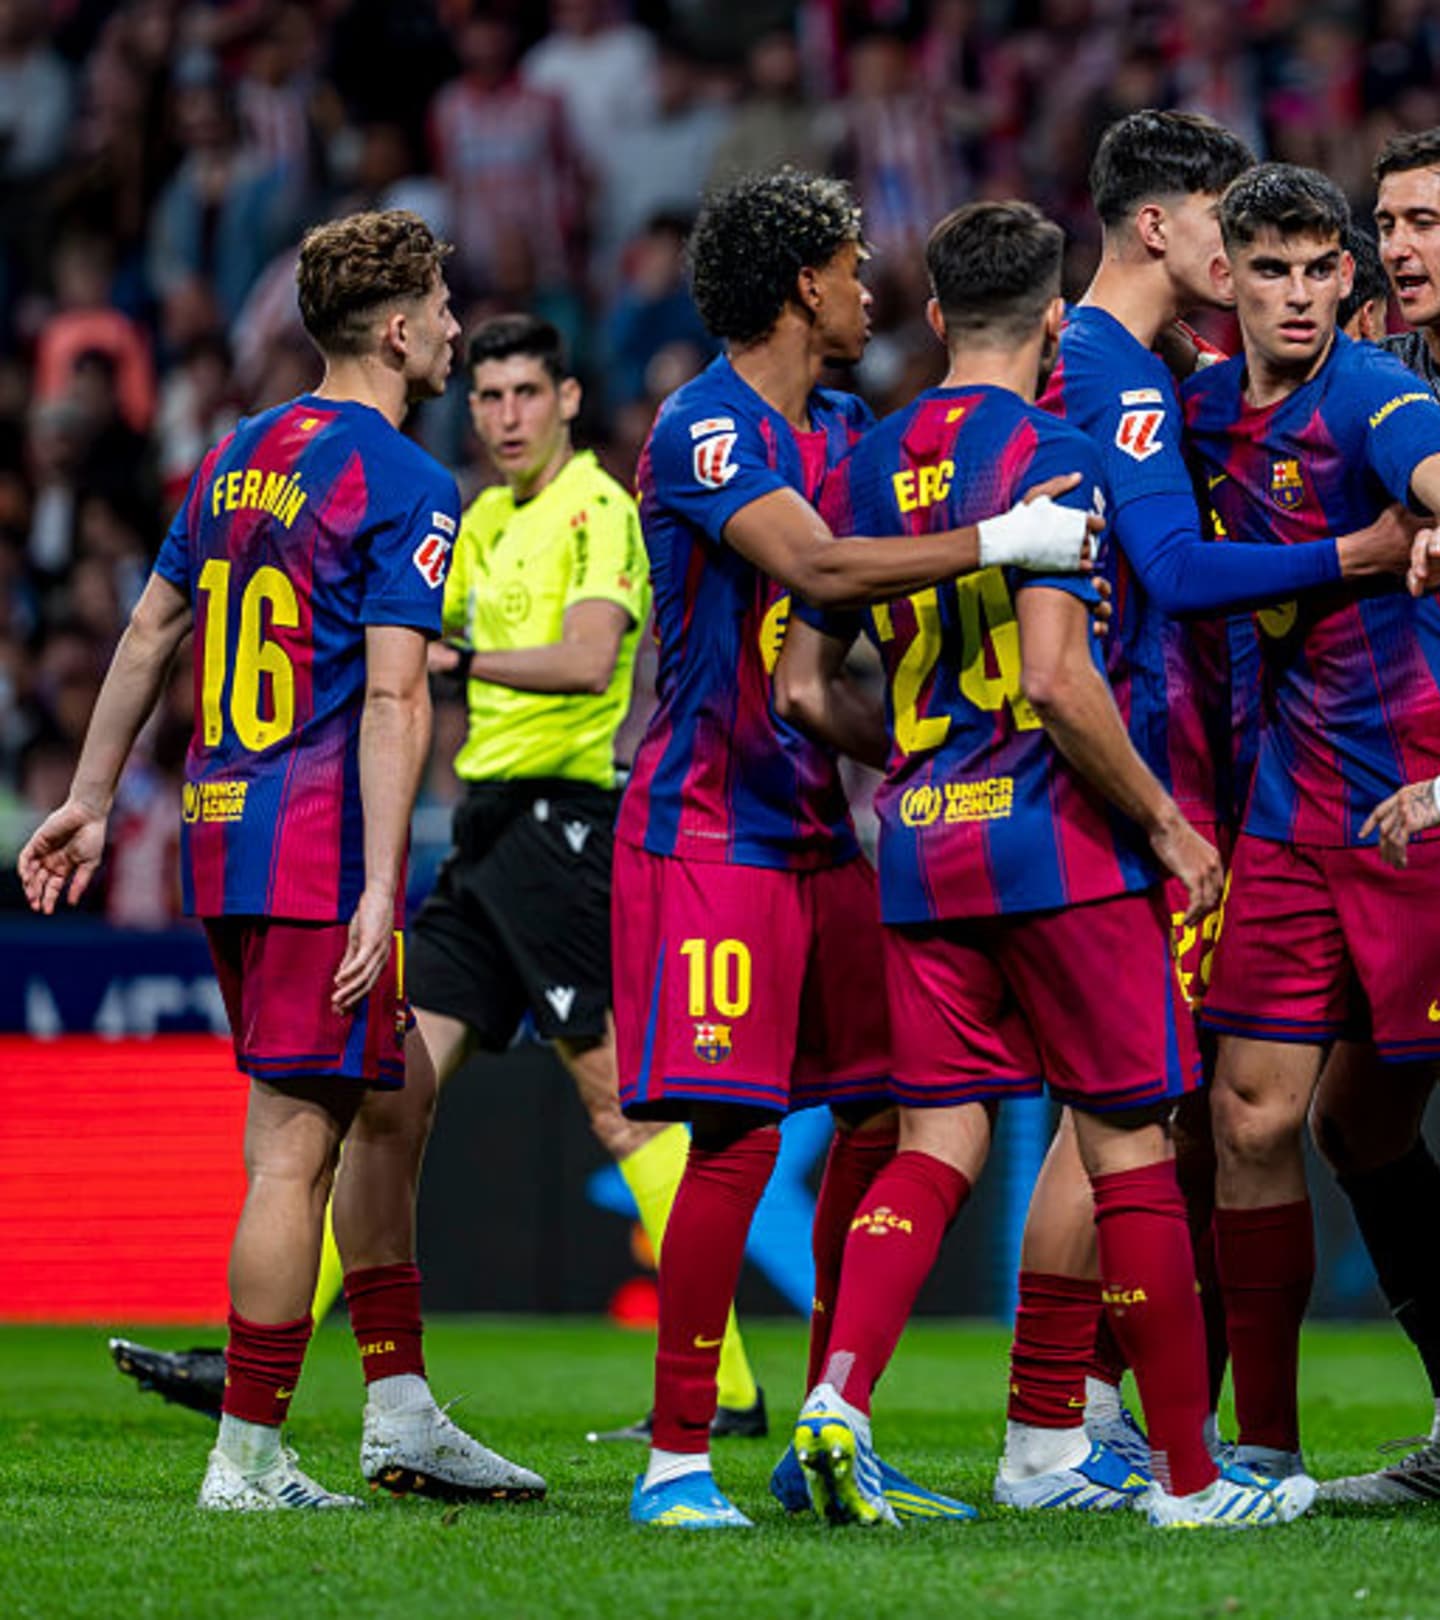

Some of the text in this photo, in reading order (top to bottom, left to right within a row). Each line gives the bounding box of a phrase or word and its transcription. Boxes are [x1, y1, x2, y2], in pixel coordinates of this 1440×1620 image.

[213, 470, 306, 528] FERMÍN
[197, 558, 298, 752] 16
[680, 939, 752, 1017] 10
